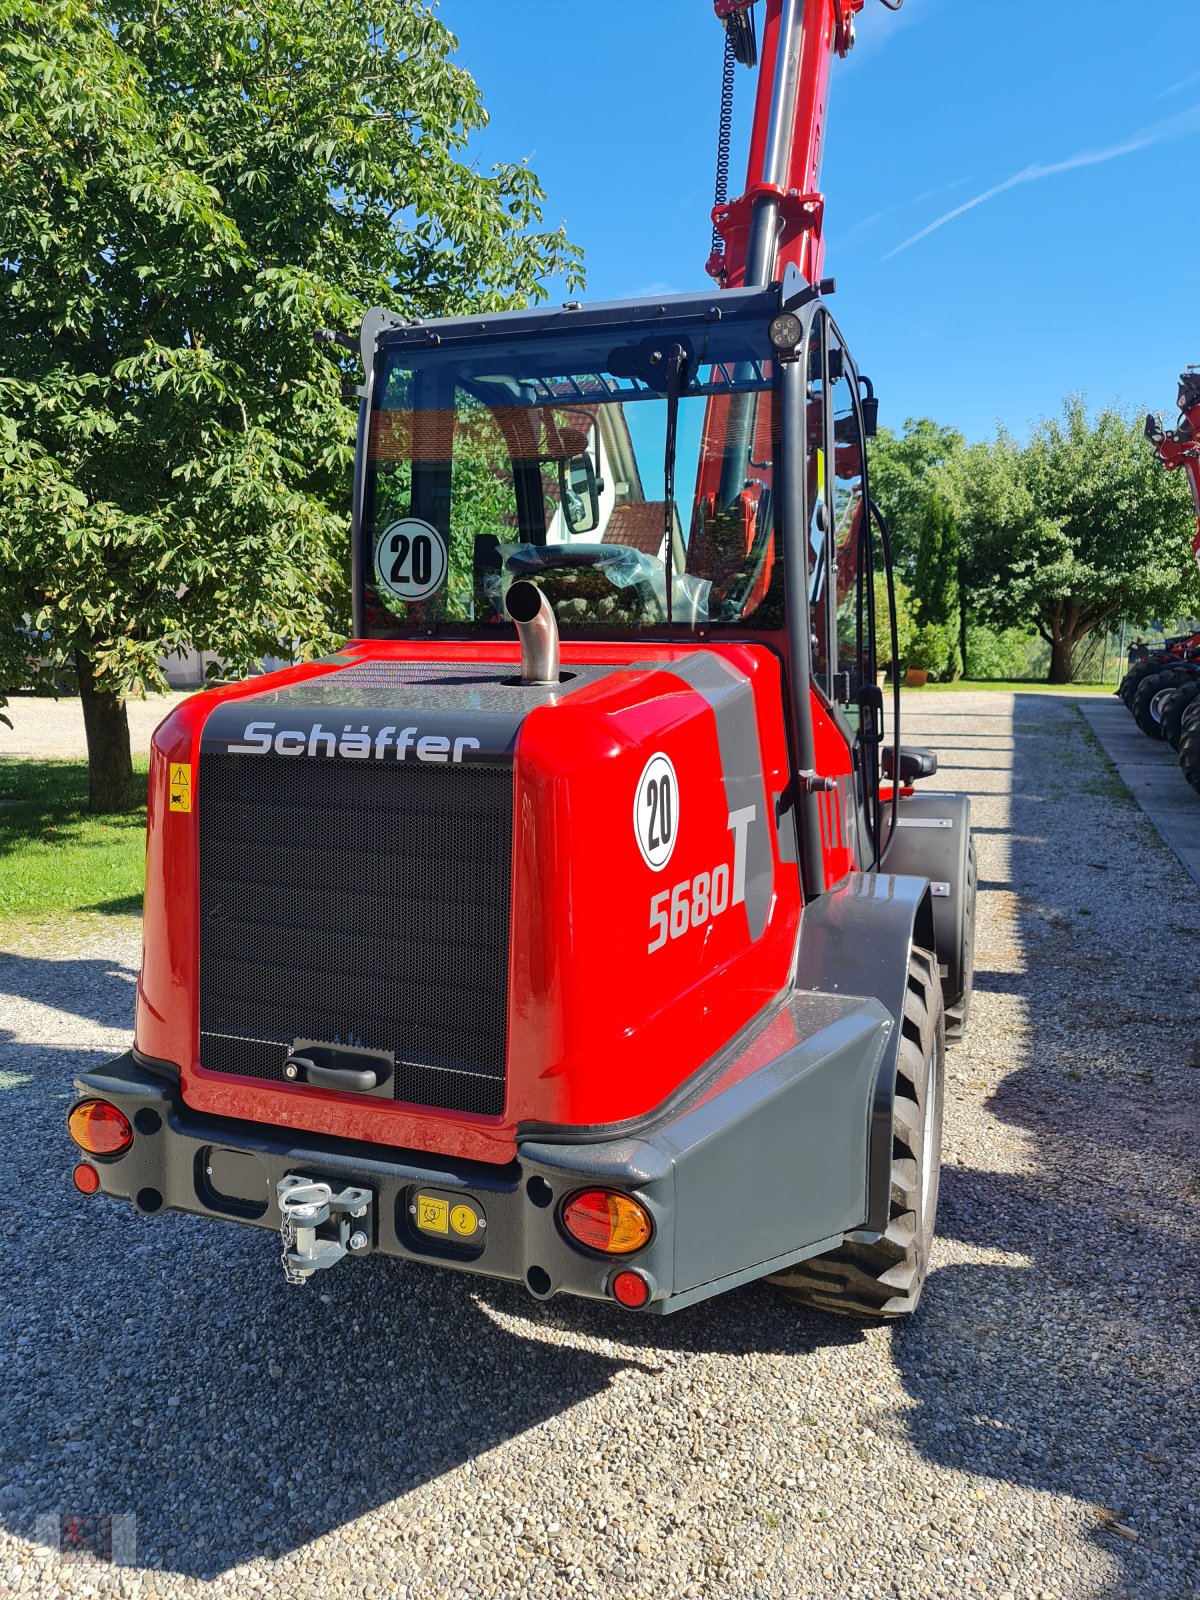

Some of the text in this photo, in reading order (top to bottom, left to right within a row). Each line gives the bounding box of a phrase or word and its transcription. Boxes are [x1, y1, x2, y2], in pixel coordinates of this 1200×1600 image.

[390, 534, 432, 585] 20
[227, 721, 480, 763] Schäffer
[646, 774, 671, 852] 20
